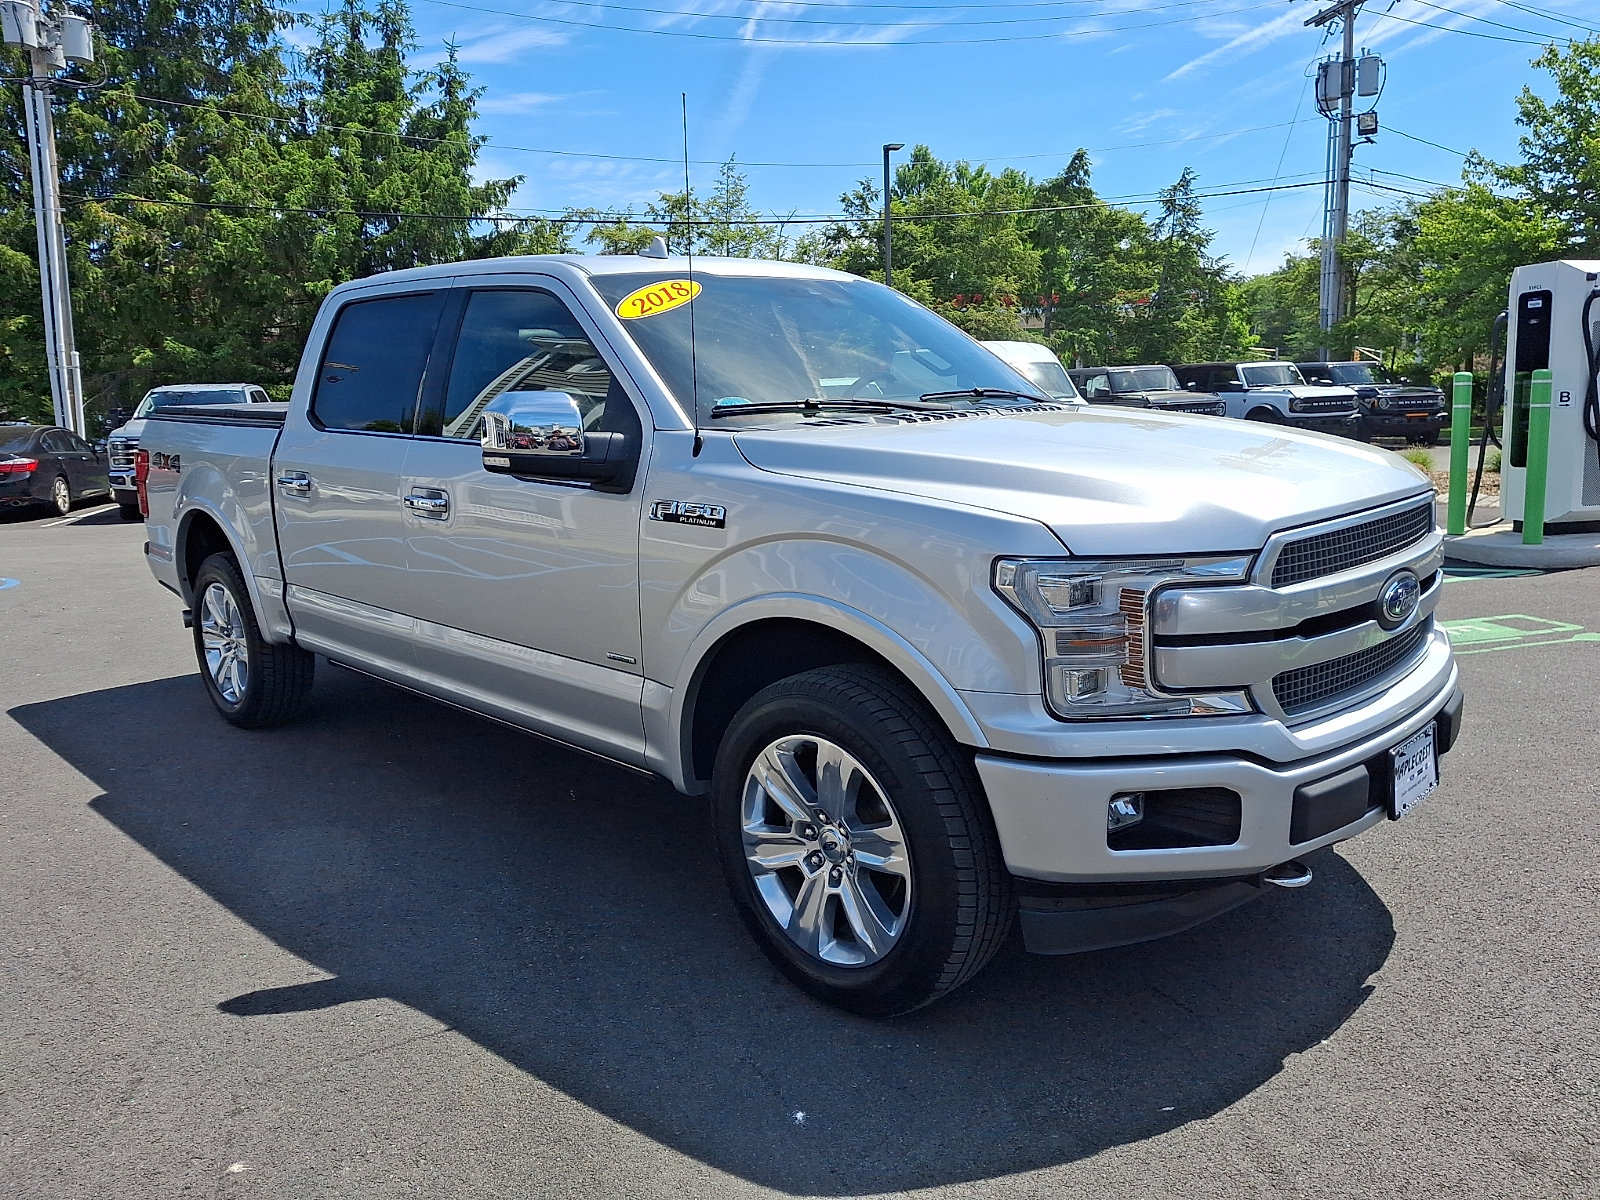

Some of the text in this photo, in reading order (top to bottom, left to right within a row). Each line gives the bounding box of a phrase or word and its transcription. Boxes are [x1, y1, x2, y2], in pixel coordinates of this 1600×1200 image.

[632, 282, 690, 314] 2018
[1559, 391, 1571, 403] B
[680, 516, 716, 526] PLATINUM
[1395, 741, 1432, 781] MAPLECREST
